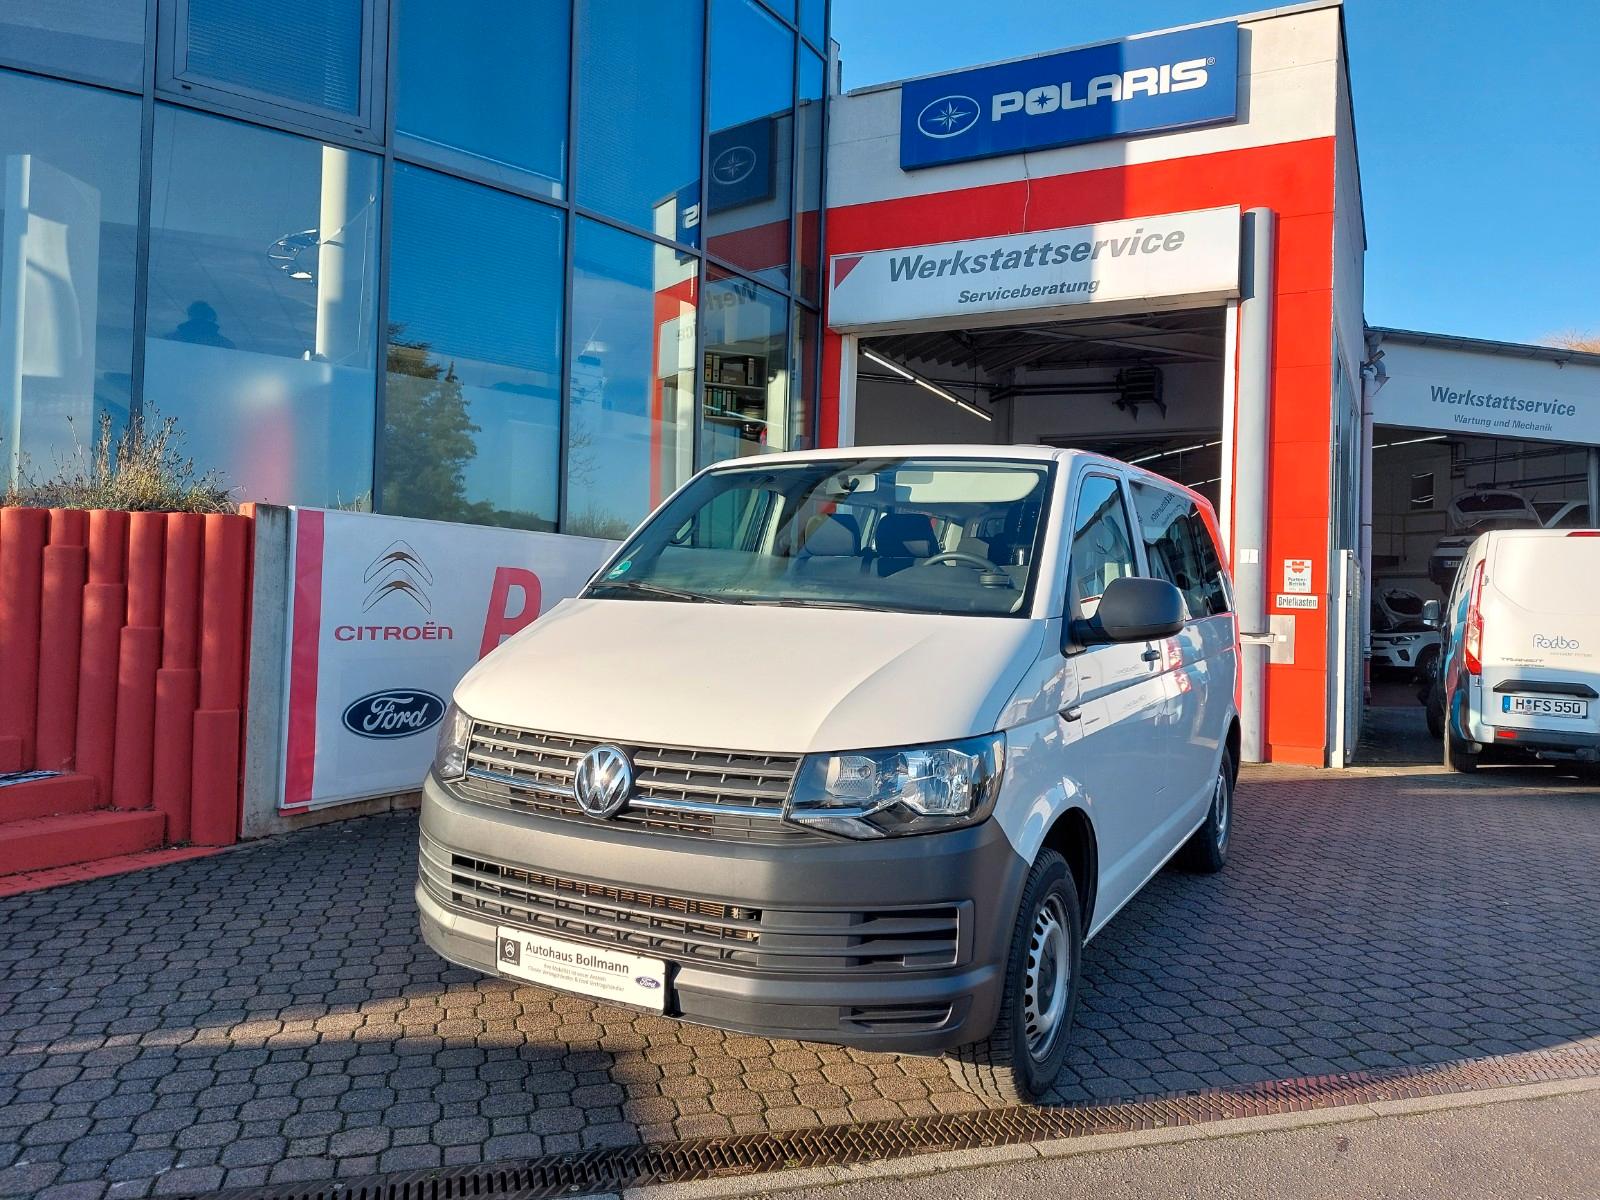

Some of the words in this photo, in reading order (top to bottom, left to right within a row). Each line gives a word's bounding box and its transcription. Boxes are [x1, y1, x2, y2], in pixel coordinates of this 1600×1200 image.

[992, 57, 1209, 121] POLARIS
[889, 228, 1185, 282] Werkstattservice
[957, 279, 1100, 304] Serviceberatung
[1430, 385, 1576, 417] Werkstattservice
[1454, 414, 1491, 428] Wartung
[1493, 420, 1510, 428] und
[1512, 420, 1553, 432] Mechanik
[1278, 596, 1317, 608] Briefkasten
[363, 697, 430, 731] Ford
[525, 941, 574, 963] Autohaus
[576, 953, 629, 974] Bollmann
